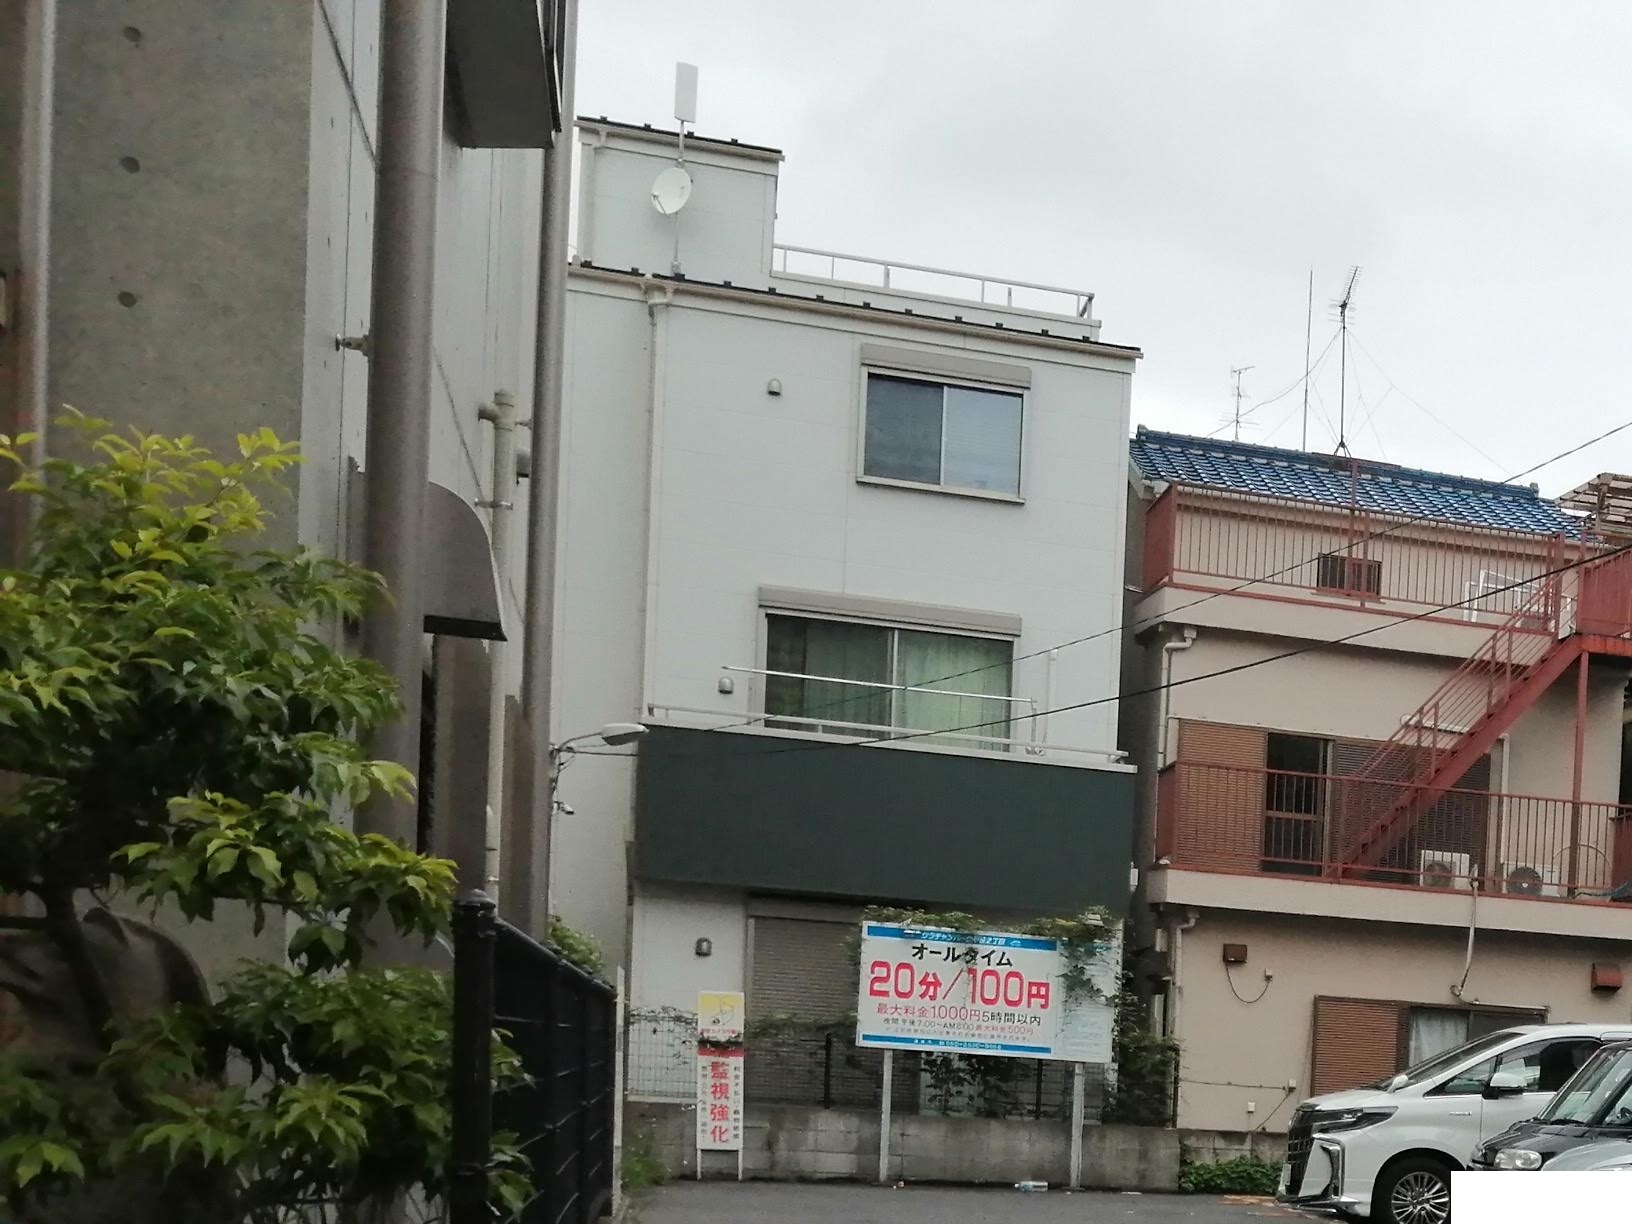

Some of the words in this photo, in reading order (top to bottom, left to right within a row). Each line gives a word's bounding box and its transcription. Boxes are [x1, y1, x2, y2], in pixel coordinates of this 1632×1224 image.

[911, 943, 1013, 968] オールタイム
[710, 1061, 730, 1144] 監視強化
